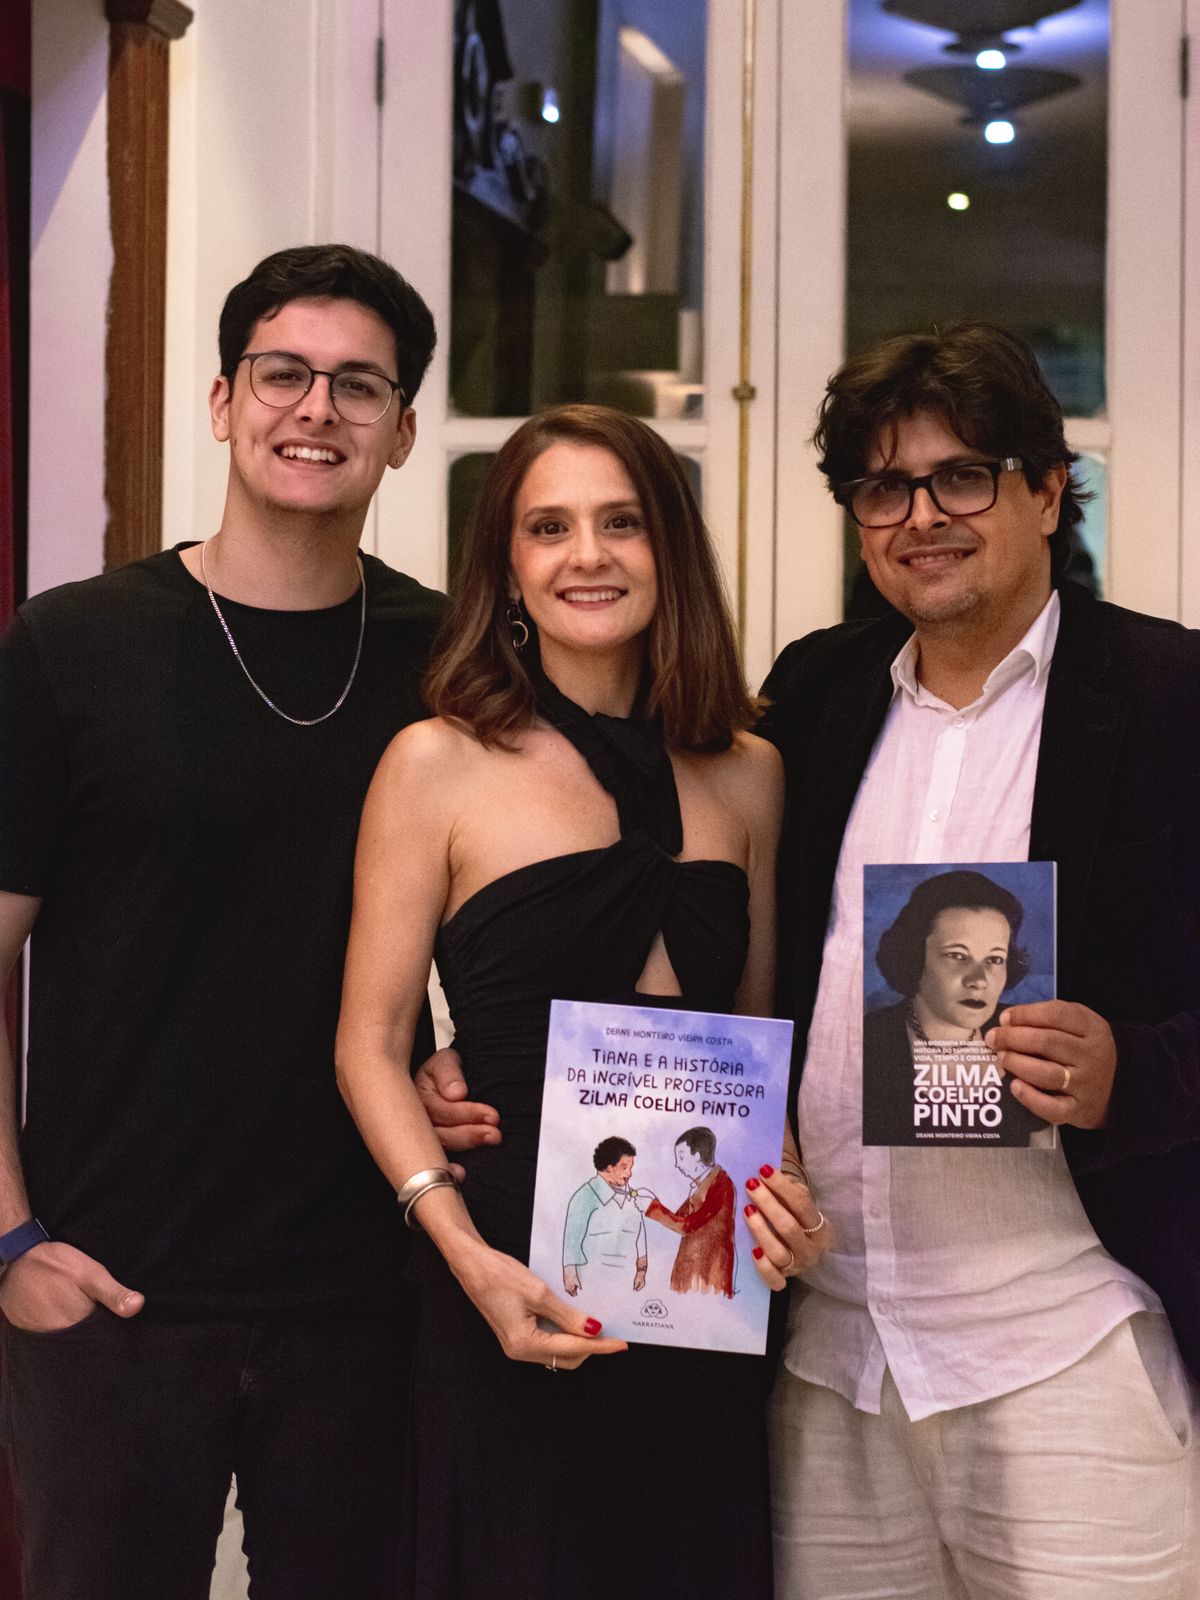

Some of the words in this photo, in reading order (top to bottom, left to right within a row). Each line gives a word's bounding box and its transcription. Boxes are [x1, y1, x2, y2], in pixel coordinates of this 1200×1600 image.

[606, 1027, 631, 1036] DEANE
[633, 1030, 676, 1041] MONTEIRO
[678, 1034, 704, 1044] VIEIRA
[705, 1037, 733, 1046] COSTA
[644, 1053, 653, 1067] E
[658, 1056, 668, 1070] A
[567, 1067, 586, 1083] DA
[664, 1077, 766, 1099] PROFESSORA
[913, 1064, 1003, 1087] ZILMA
[633, 1095, 695, 1113] COELHO
[914, 1086, 1002, 1104] COELHO
[913, 1104, 1003, 1127] PINTO
